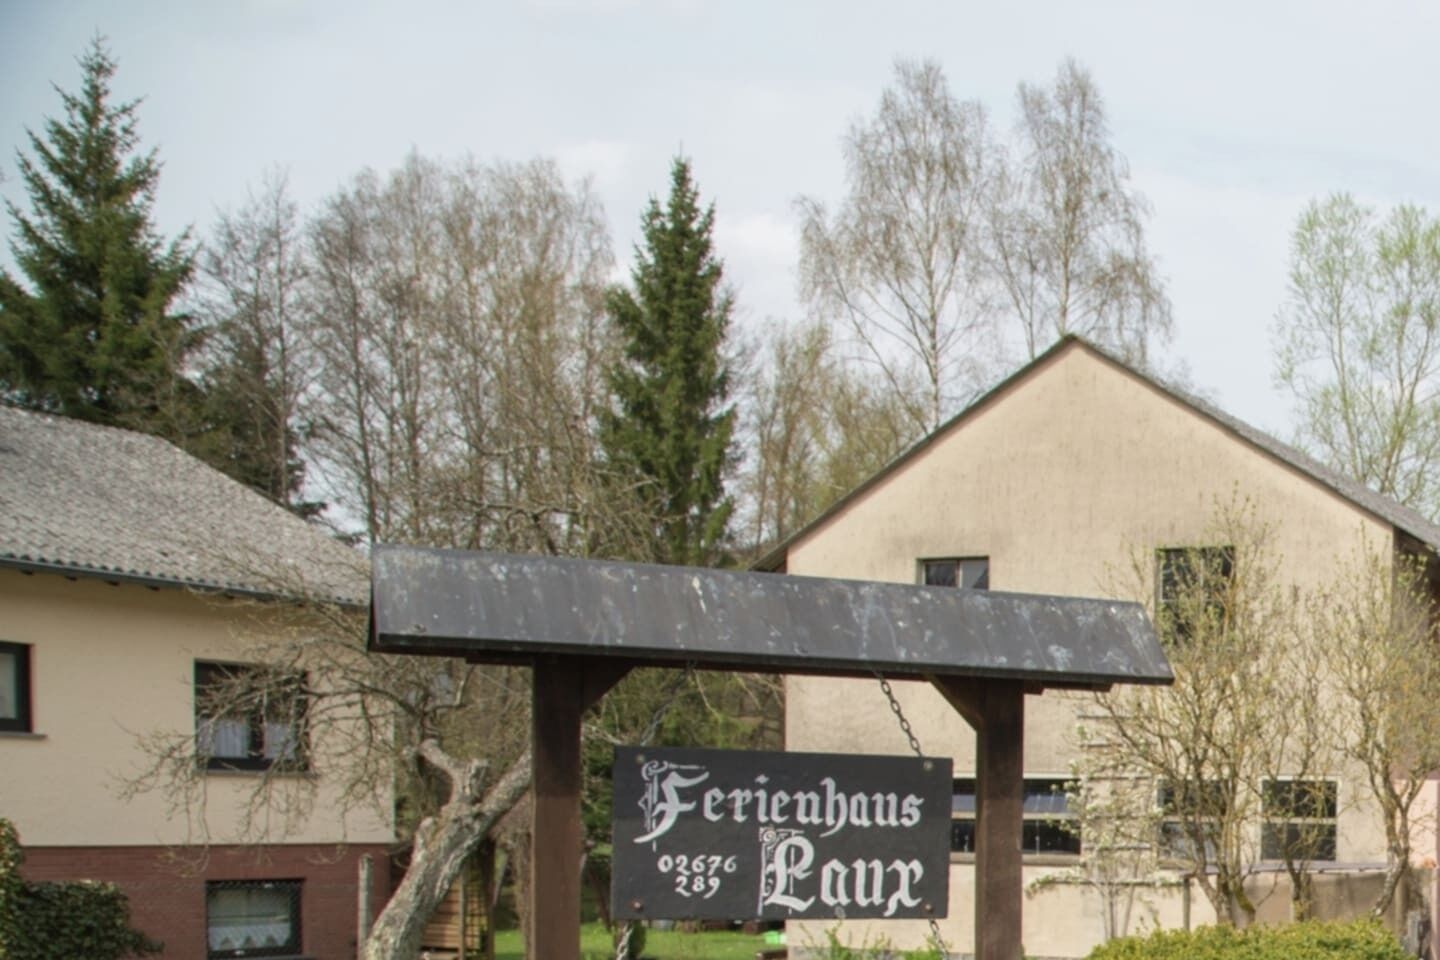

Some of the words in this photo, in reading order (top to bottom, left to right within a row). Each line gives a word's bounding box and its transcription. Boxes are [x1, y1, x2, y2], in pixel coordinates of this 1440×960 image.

[633, 763, 924, 845] Ferienhaus
[657, 854, 737, 876] 02676
[675, 876, 720, 899] 289
[760, 831, 924, 916] Laux
